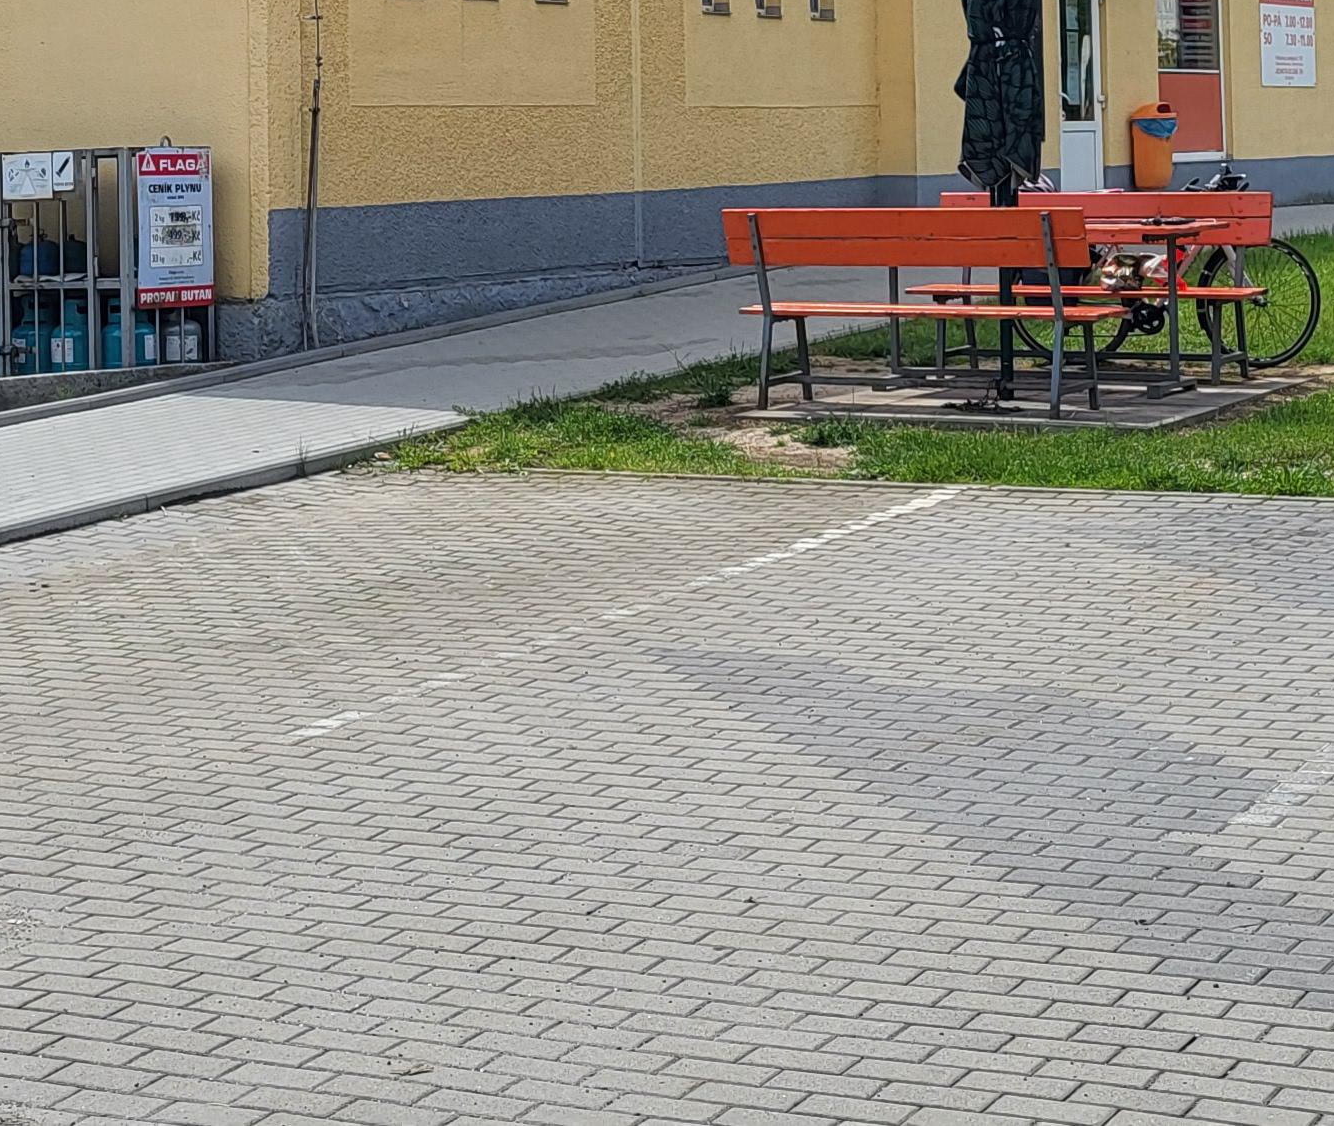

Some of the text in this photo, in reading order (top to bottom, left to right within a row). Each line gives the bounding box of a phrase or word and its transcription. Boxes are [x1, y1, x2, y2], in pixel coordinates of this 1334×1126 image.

[1263, 32, 1272, 45] SO
[148, 183, 202, 194] CENÍK PLYNU
[154, 213, 159, 222] 2
[181, 288, 212, 301] BUTAN
